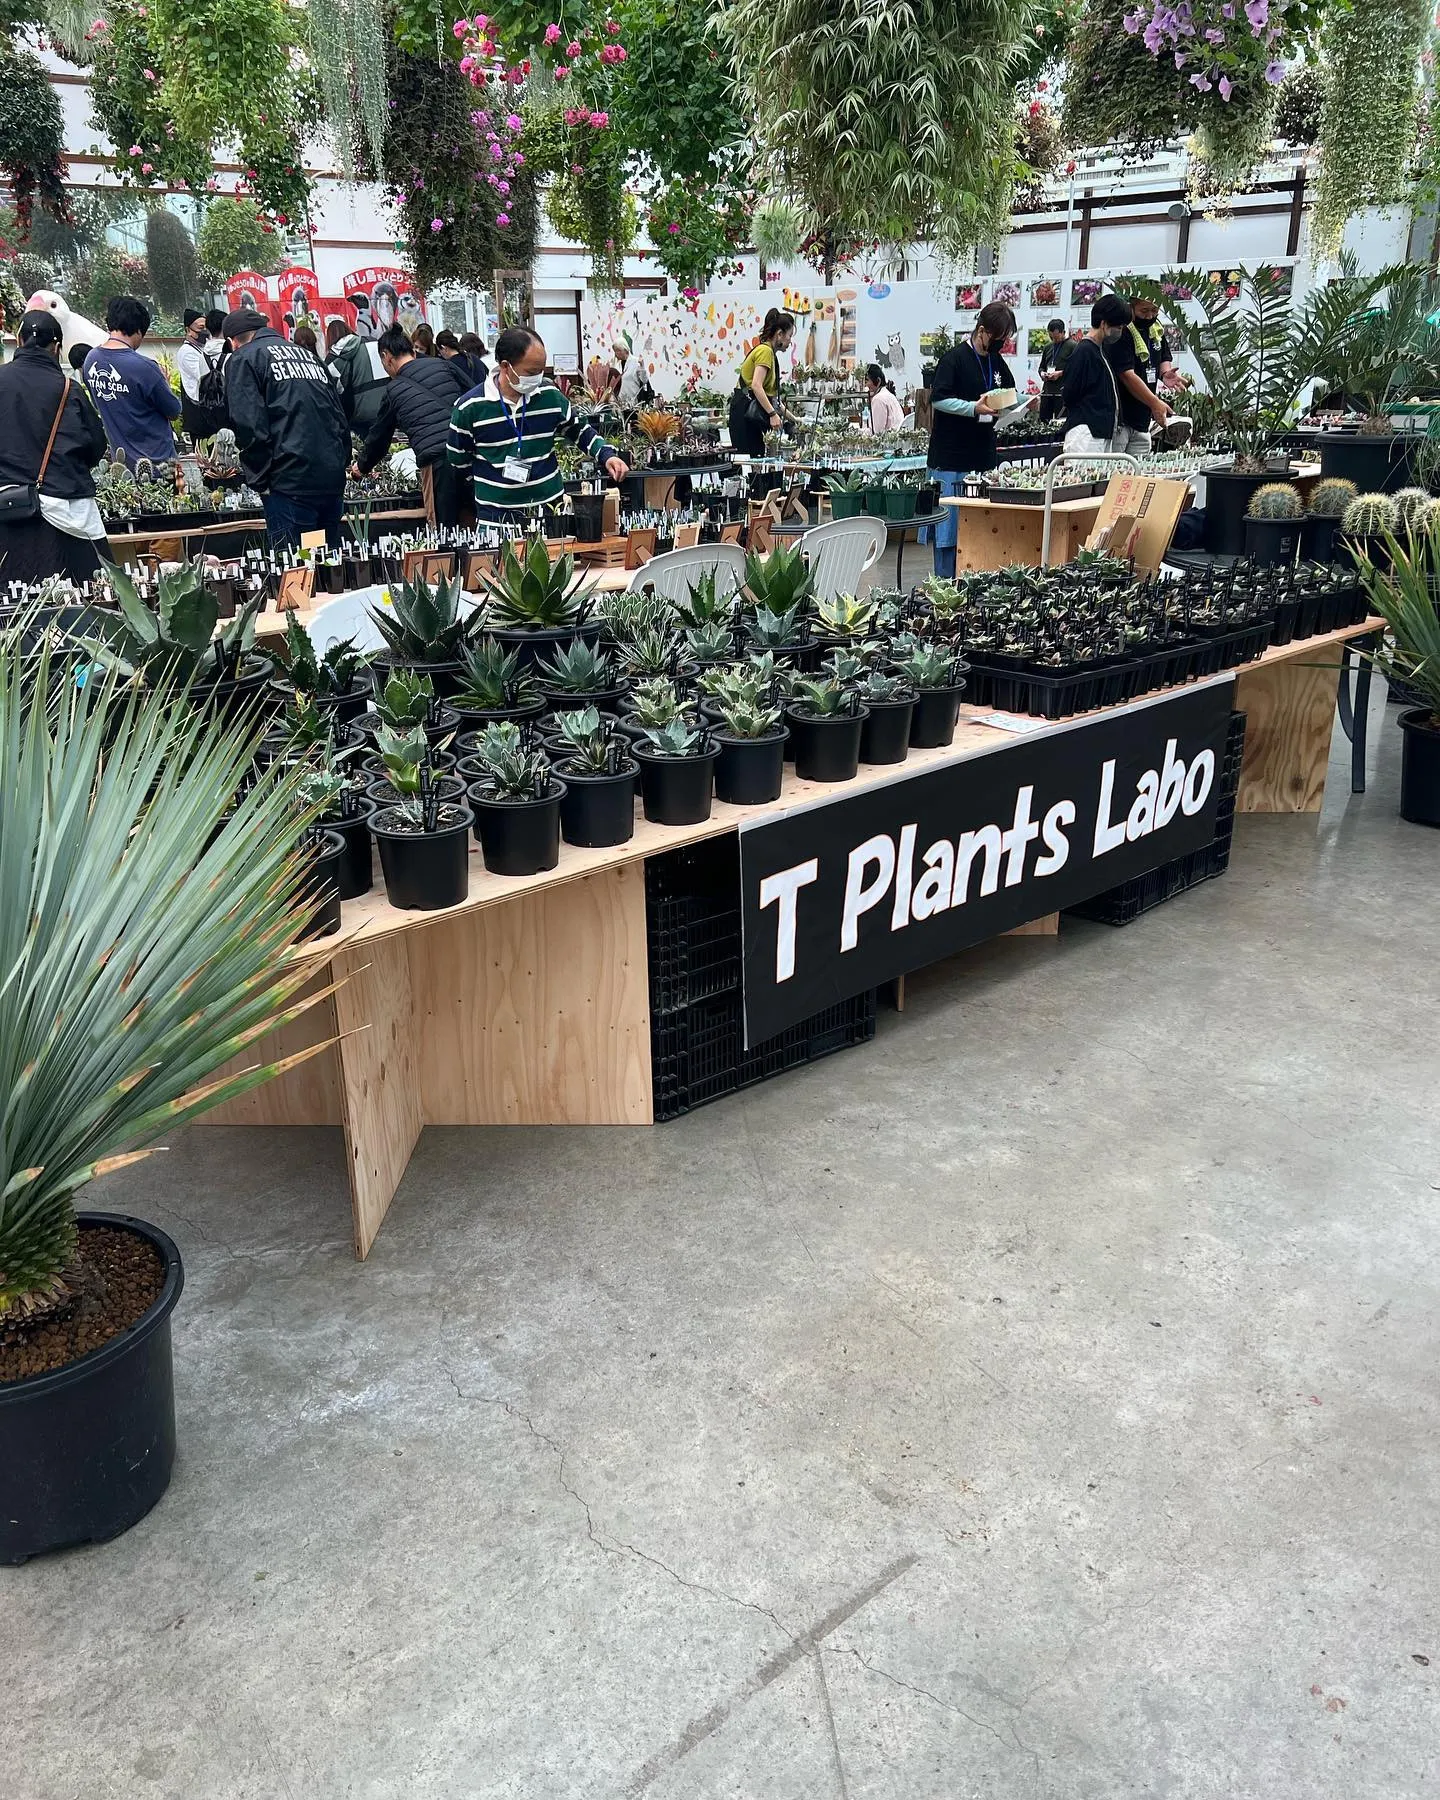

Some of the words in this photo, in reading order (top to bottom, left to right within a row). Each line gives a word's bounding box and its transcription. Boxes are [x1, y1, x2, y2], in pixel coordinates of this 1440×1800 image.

[267, 345, 317, 364] SEATTLE
[270, 361, 329, 384] SEAHAWKS
[107, 381, 130, 393] SCBA
[759, 857, 819, 984] T
[839, 785, 1077, 953] Plants
[1091, 738, 1216, 859] Labo
